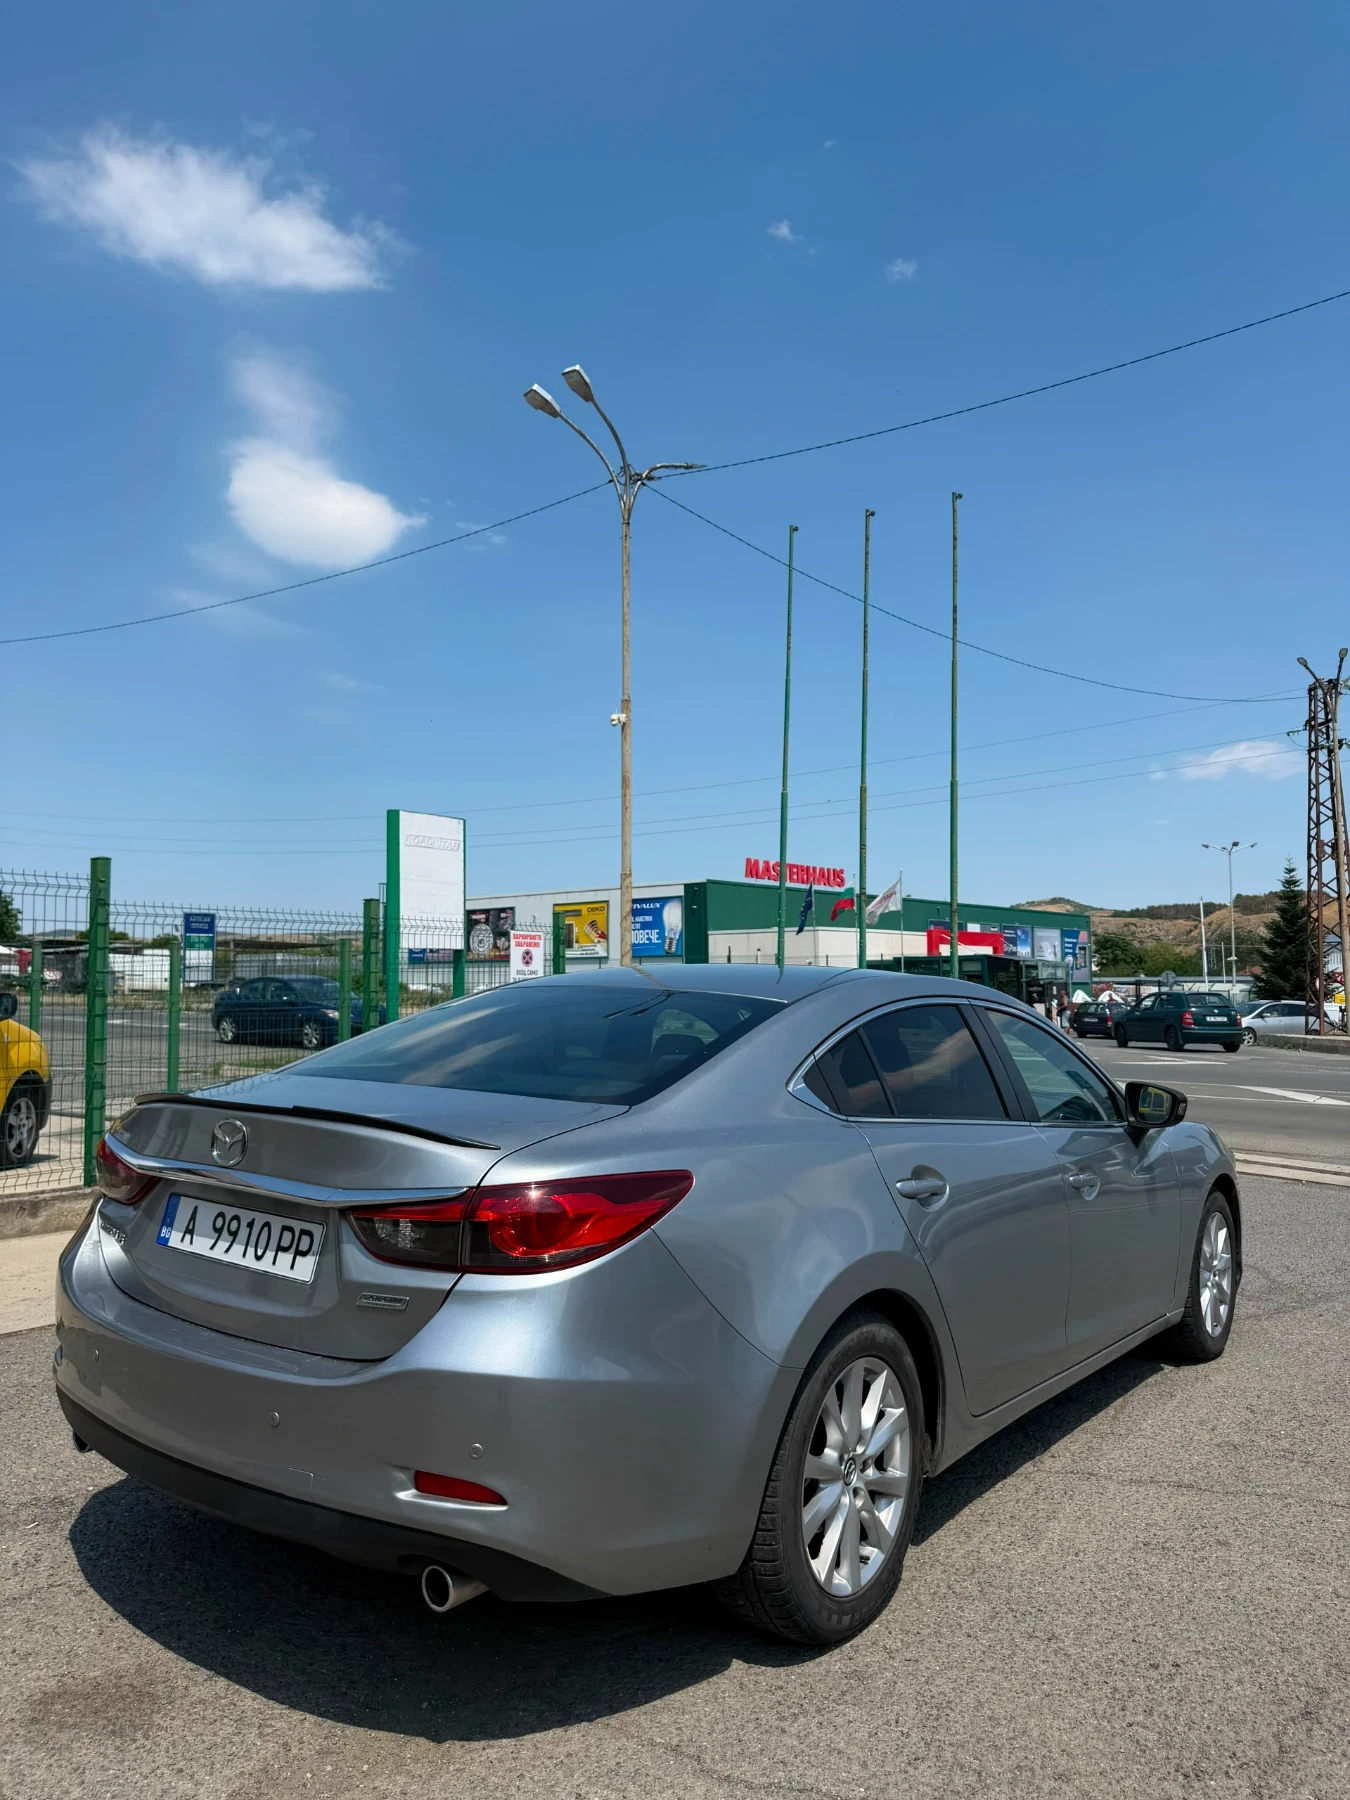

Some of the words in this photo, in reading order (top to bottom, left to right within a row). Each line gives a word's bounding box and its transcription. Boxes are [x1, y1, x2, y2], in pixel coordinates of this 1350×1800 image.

[745, 857, 845, 888] MASTERHAUS
[512, 933, 542, 941] ПАРКИРАНЕТО
[160, 1226, 172, 1238] BG
[180, 1205, 199, 1246] A
